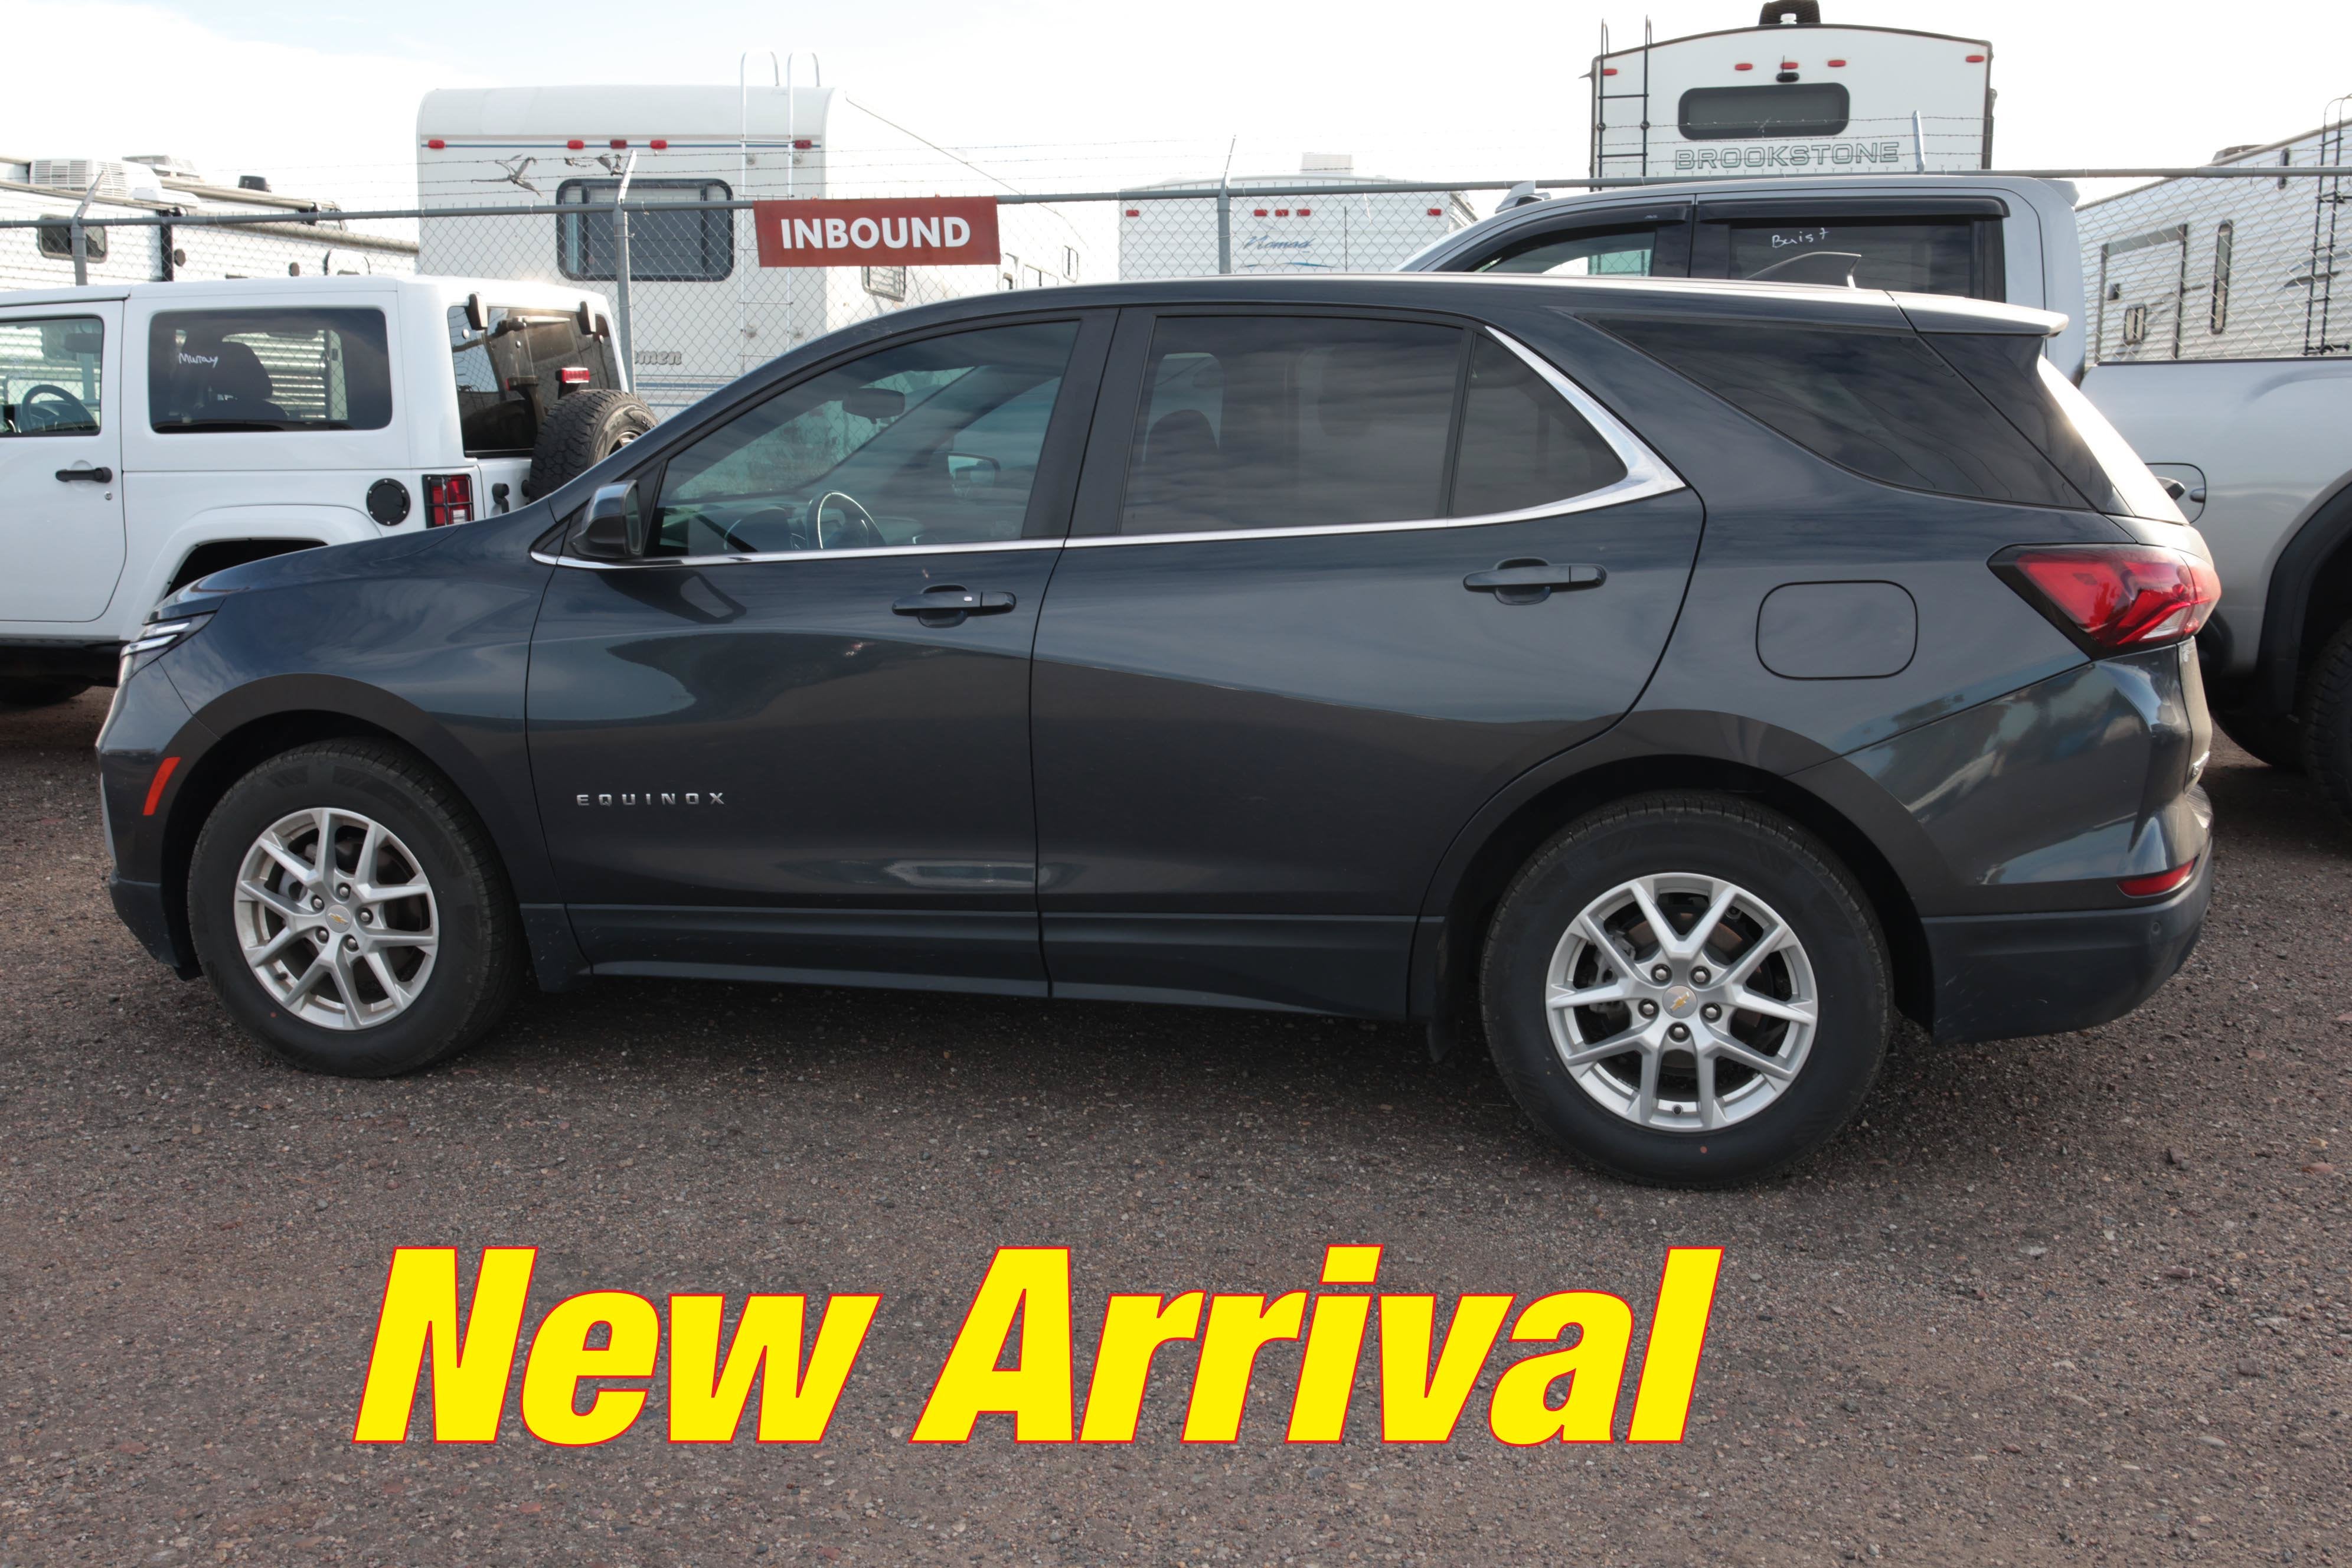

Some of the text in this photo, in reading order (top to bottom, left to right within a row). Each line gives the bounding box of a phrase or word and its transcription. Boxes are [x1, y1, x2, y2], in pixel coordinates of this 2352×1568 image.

[1675, 142, 1899, 169] BROOKSTONE
[780, 217, 971, 249] INBOUND
[1243, 235, 1317, 250] Nomad
[178, 352, 218, 368] Murray
[576, 792, 724, 806] EQUINOX
